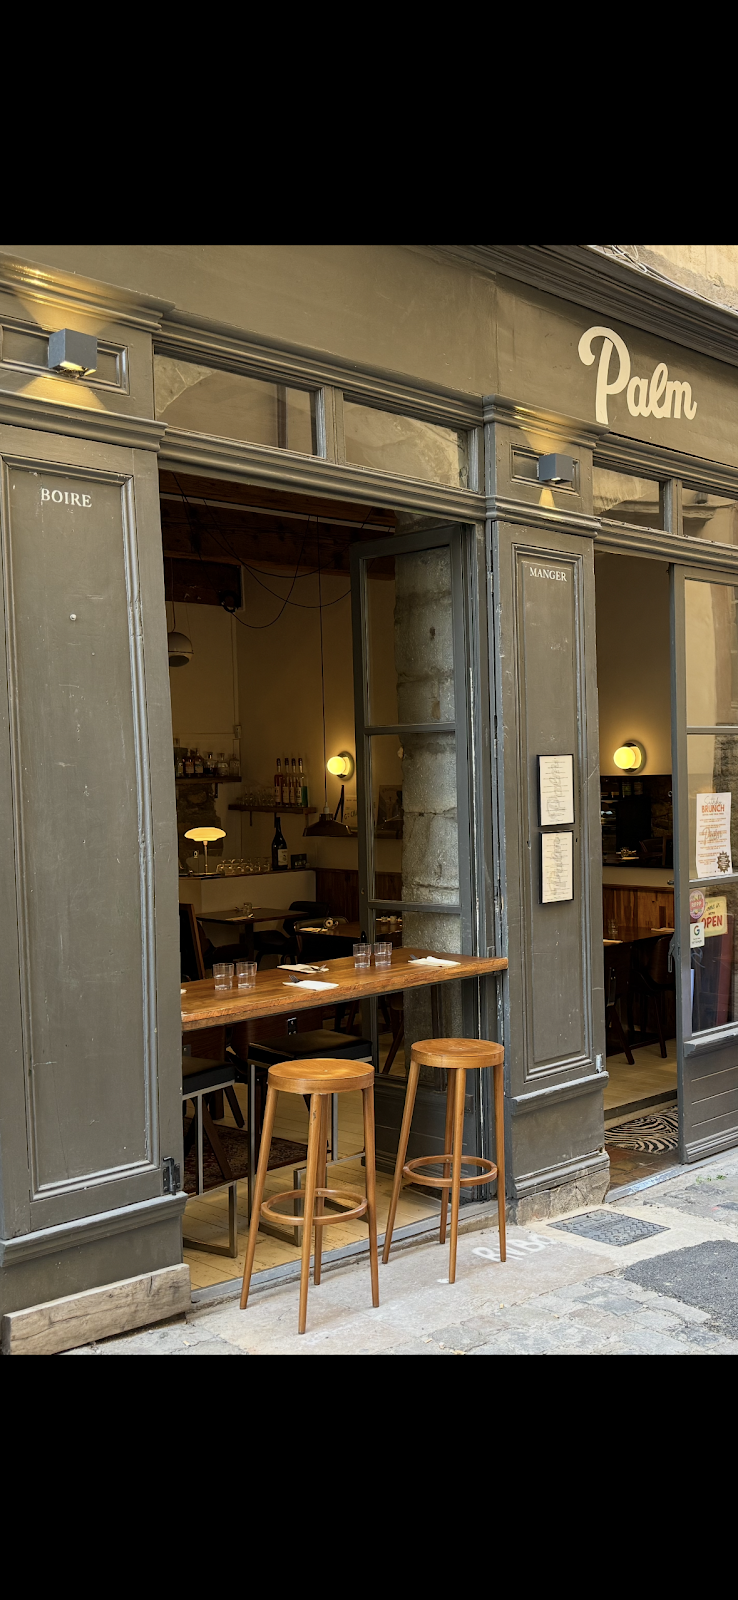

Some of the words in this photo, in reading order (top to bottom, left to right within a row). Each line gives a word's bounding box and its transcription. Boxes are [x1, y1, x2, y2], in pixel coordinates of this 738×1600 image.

[577, 326, 697, 425] Palm
[41, 488, 92, 508] BOIRE
[529, 566, 567, 582] MANGER
[702, 804, 725, 814] BRUNCH
[701, 915, 723, 929] OPEN
